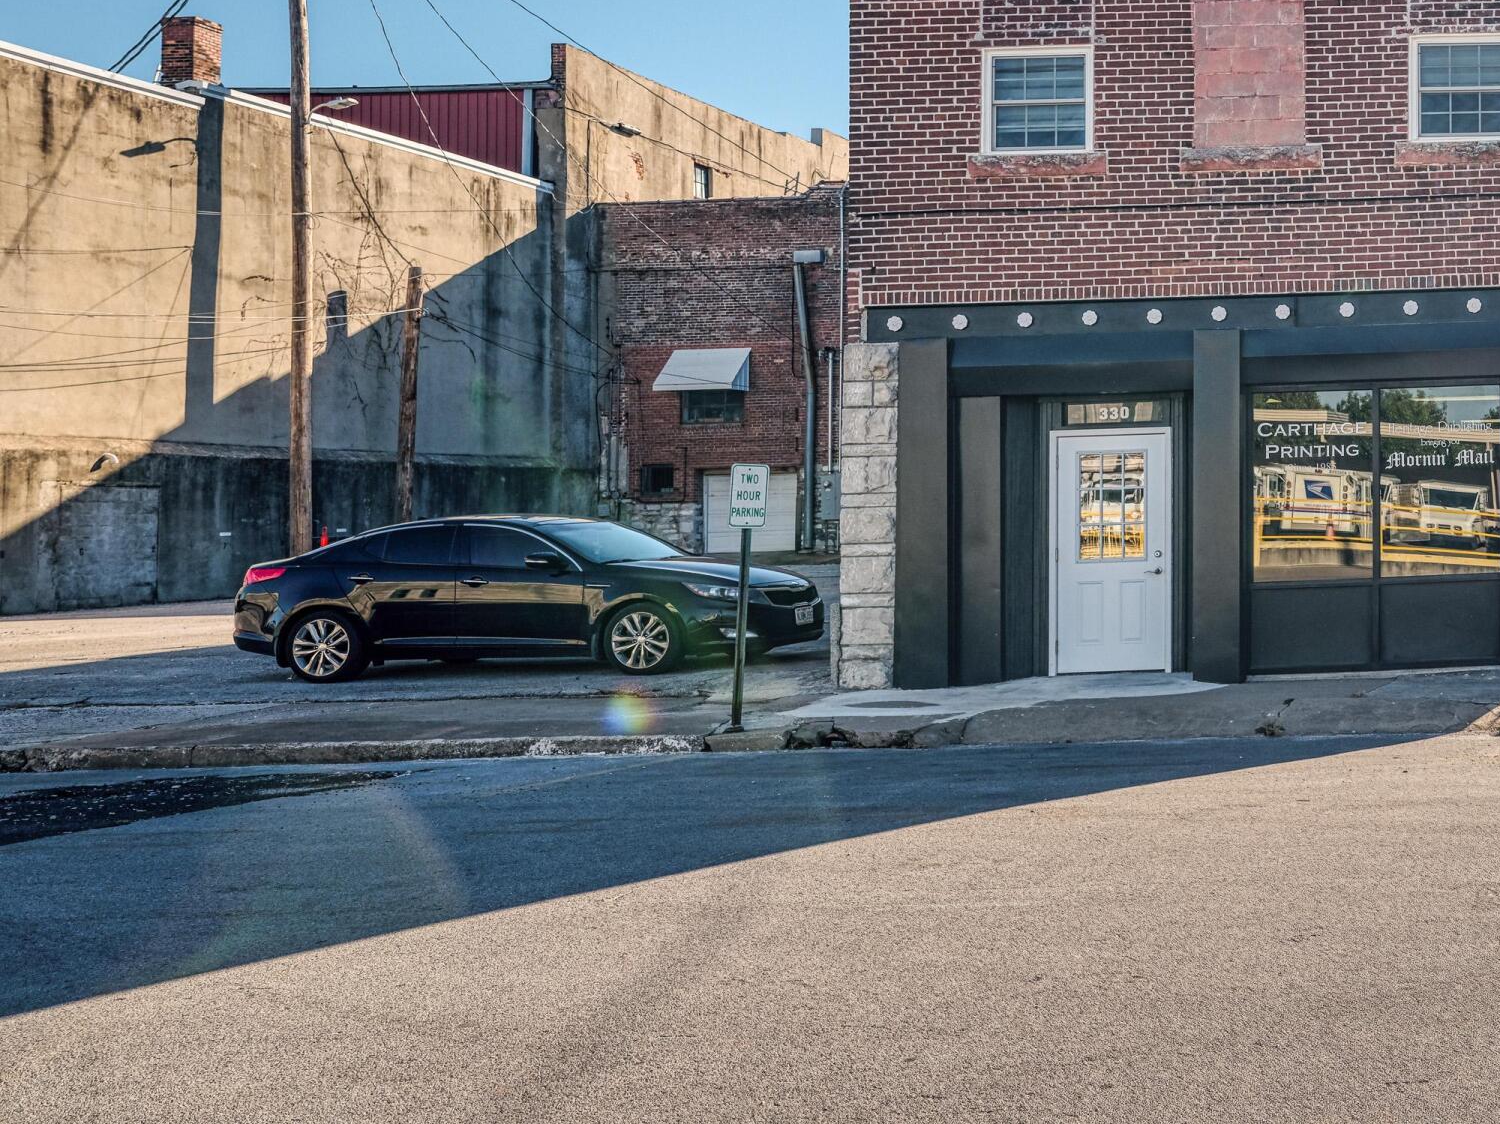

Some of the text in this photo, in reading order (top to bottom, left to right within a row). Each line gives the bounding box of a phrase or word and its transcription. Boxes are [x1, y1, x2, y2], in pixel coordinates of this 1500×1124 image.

[1099, 406, 1130, 420] 330
[1257, 422, 1366, 437] CARTHAGE
[1438, 420, 1494, 435] Publishing
[1265, 444, 1360, 460] PRINTING
[1385, 448, 1496, 470] Mornin' Mail
[741, 474, 759, 484] TWO
[736, 491, 761, 500] HOUR
[731, 507, 765, 517] PARKING
